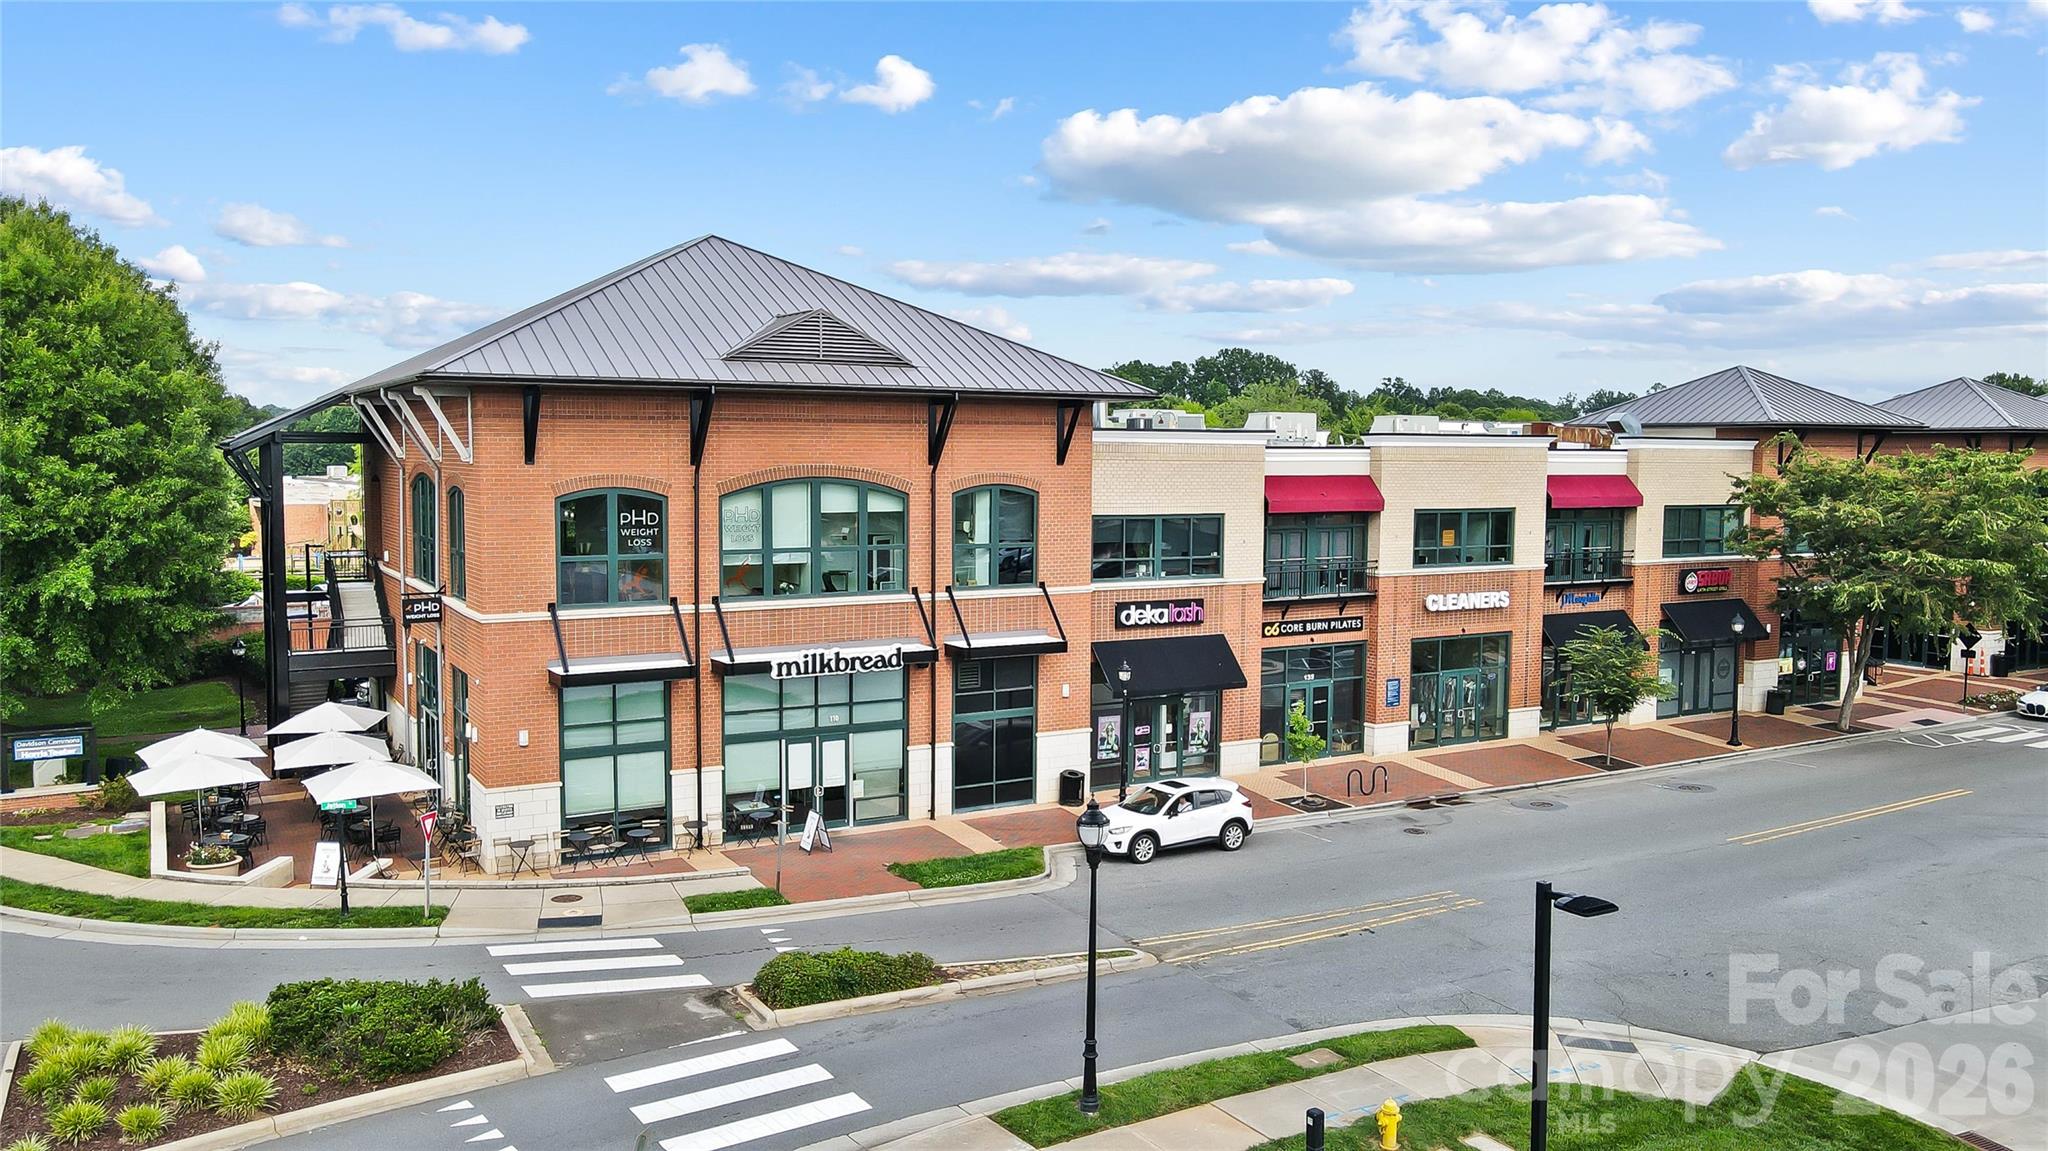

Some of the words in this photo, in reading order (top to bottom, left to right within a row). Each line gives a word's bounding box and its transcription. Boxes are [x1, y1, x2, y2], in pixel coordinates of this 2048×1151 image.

[620, 528, 659, 536] WEIGHT
[628, 538, 652, 547] LOSS
[1425, 590, 1510, 612] CLEANERS
[1120, 601, 1204, 626] dekalash
[1281, 623, 1304, 633] CORE
[1306, 622, 1328, 631] BURN
[1330, 619, 1362, 629] PILATES
[776, 647, 903, 677] milkbread
[16, 739, 47, 747] Davidson
